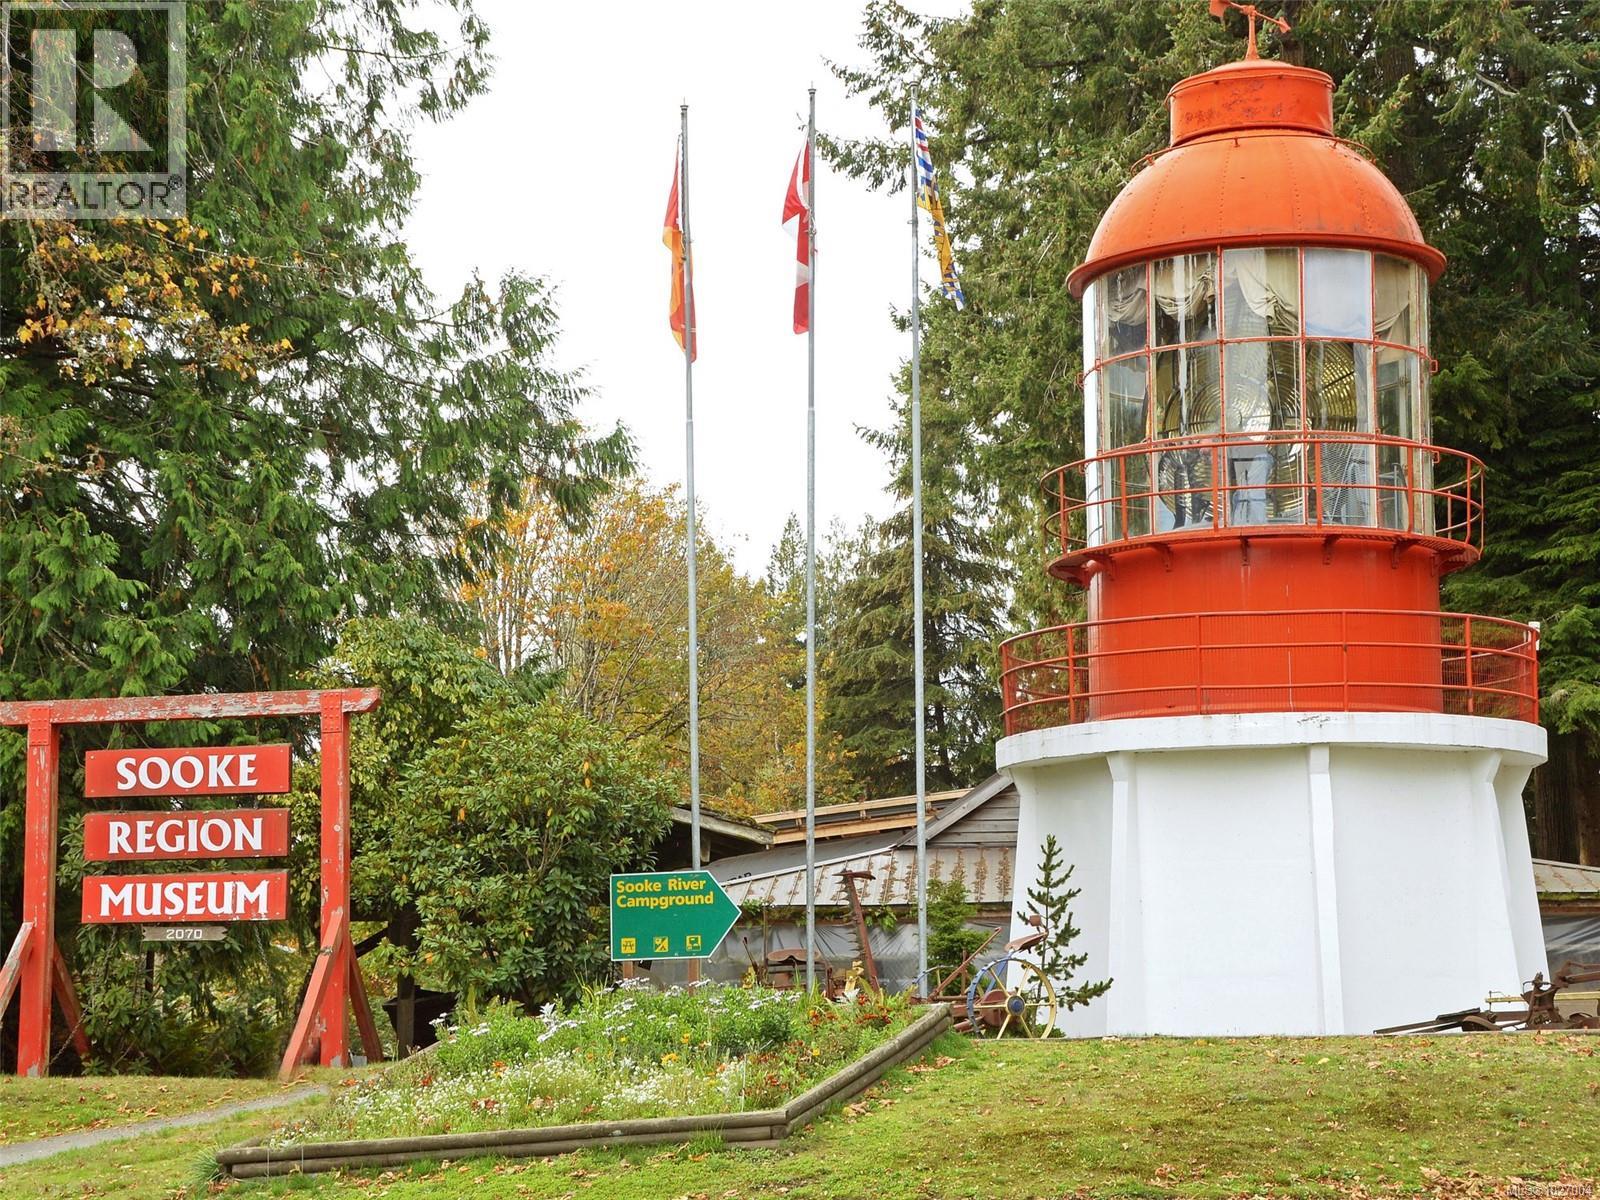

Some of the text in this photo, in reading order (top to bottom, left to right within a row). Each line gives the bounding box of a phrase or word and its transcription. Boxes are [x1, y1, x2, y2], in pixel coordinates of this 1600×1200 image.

[116, 753, 258, 790] SOOKE
[108, 817, 263, 854] REGION
[99, 879, 270, 917] MUSEUM
[616, 878, 706, 893] Sooke River
[616, 891, 714, 909] Campground
[165, 929, 203, 939] 2070
